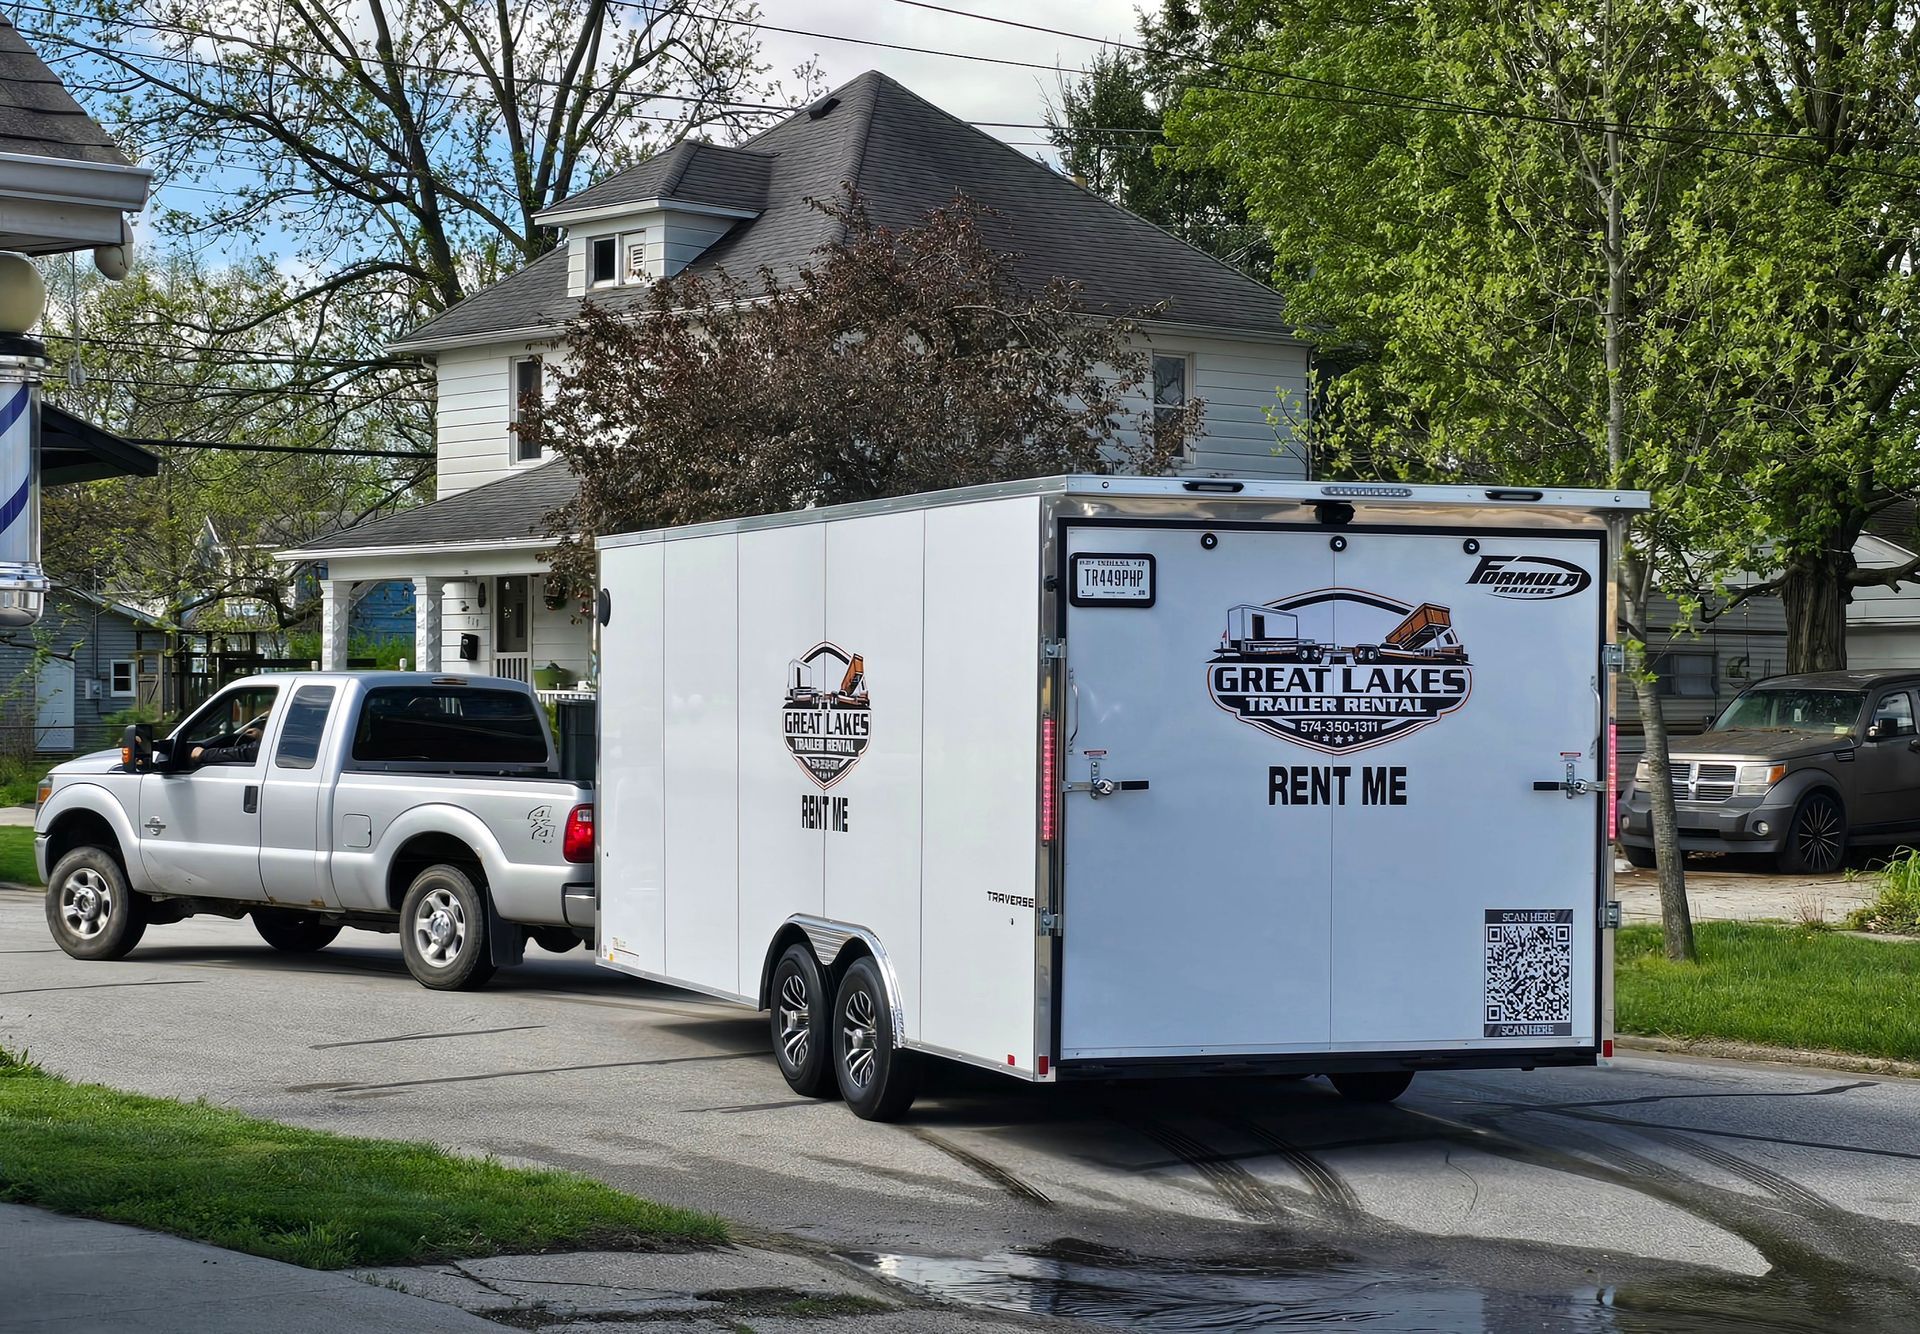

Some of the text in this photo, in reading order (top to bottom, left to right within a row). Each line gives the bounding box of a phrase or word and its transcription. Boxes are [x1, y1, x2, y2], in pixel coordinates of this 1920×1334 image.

[1084, 569, 1144, 587] TR449PHP
[1465, 555, 1582, 587] FORMULA
[1492, 586, 1556, 594] TRAILERS
[1214, 667, 1466, 694] GREAT LAKES
[1245, 697, 1427, 713] TRAILER RENTAL
[785, 712, 869, 736] GREAT LAKES
[1300, 721, 1378, 733] 574-350-1311
[794, 738, 856, 752] TRAILER RENTAL
[1268, 766, 1407, 805] RENT ME
[801, 795, 849, 832] RENT ME
[986, 890, 1035, 908] TRAVERSE
[1502, 912, 1556, 922] SCAN HERE
[1501, 1025, 1554, 1036] SCAN HERE
